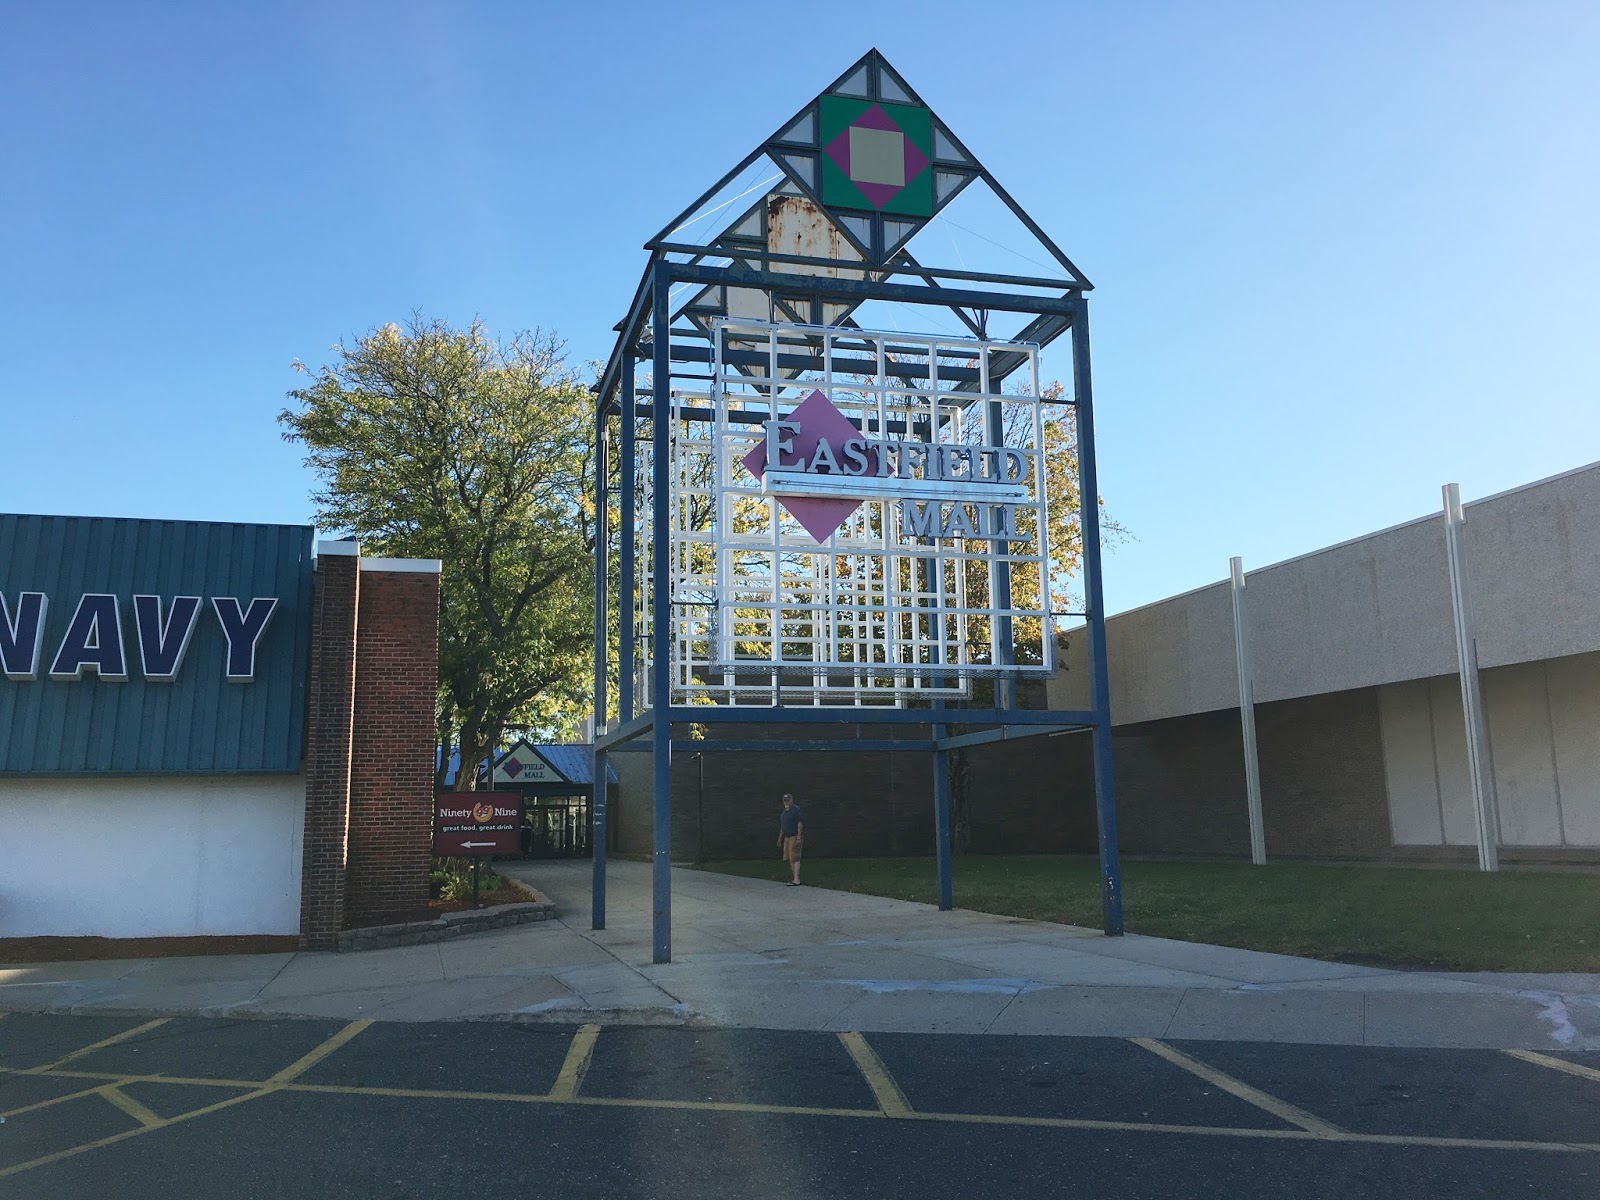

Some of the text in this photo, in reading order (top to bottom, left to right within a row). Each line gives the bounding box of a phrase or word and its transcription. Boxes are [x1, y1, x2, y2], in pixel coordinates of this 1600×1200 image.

[763, 420, 1029, 484] EASTFIELD
[900, 499, 1031, 542] MALL
[440, 808, 472, 819] Ninety
[494, 807, 517, 817] Nine
